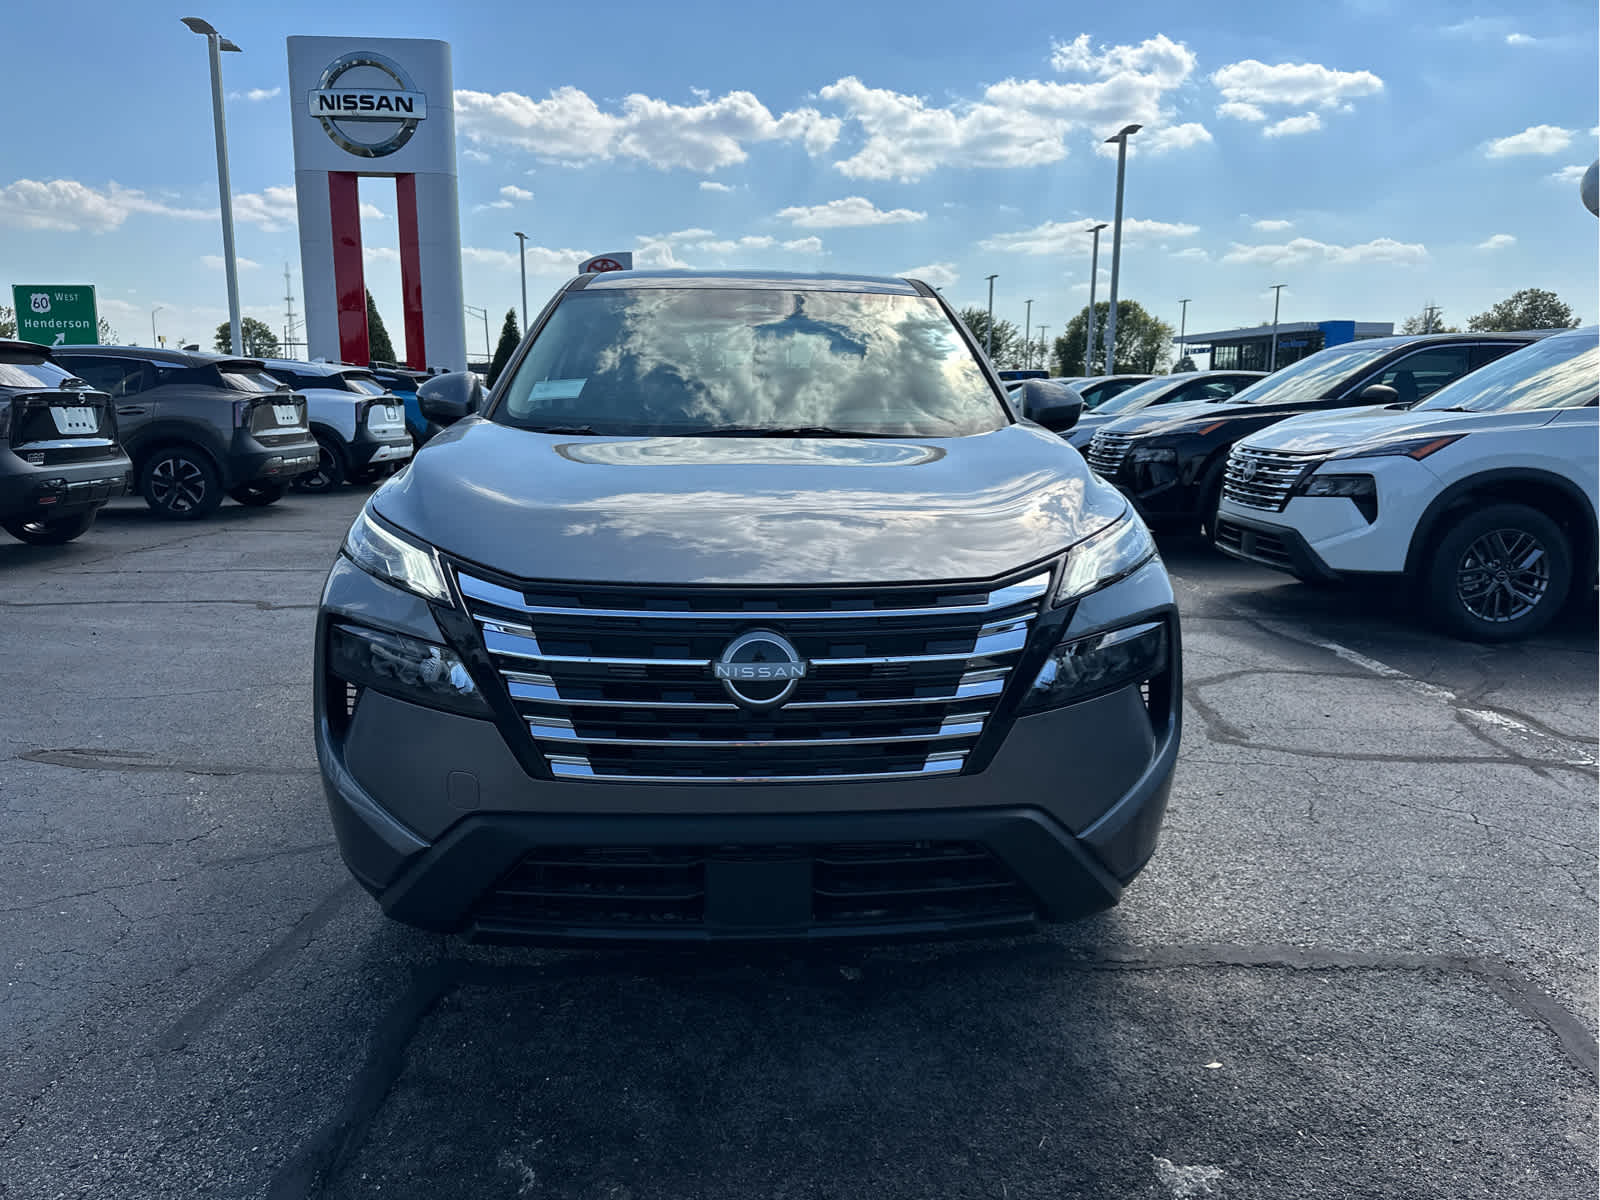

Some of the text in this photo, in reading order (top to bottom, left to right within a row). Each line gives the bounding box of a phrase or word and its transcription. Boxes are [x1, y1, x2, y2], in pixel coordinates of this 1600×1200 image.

[319, 94, 414, 113] NISSAN
[33, 292, 80, 309] 60 WEST
[24, 318, 90, 328] Henderson
[716, 665, 804, 678] NISSAN
